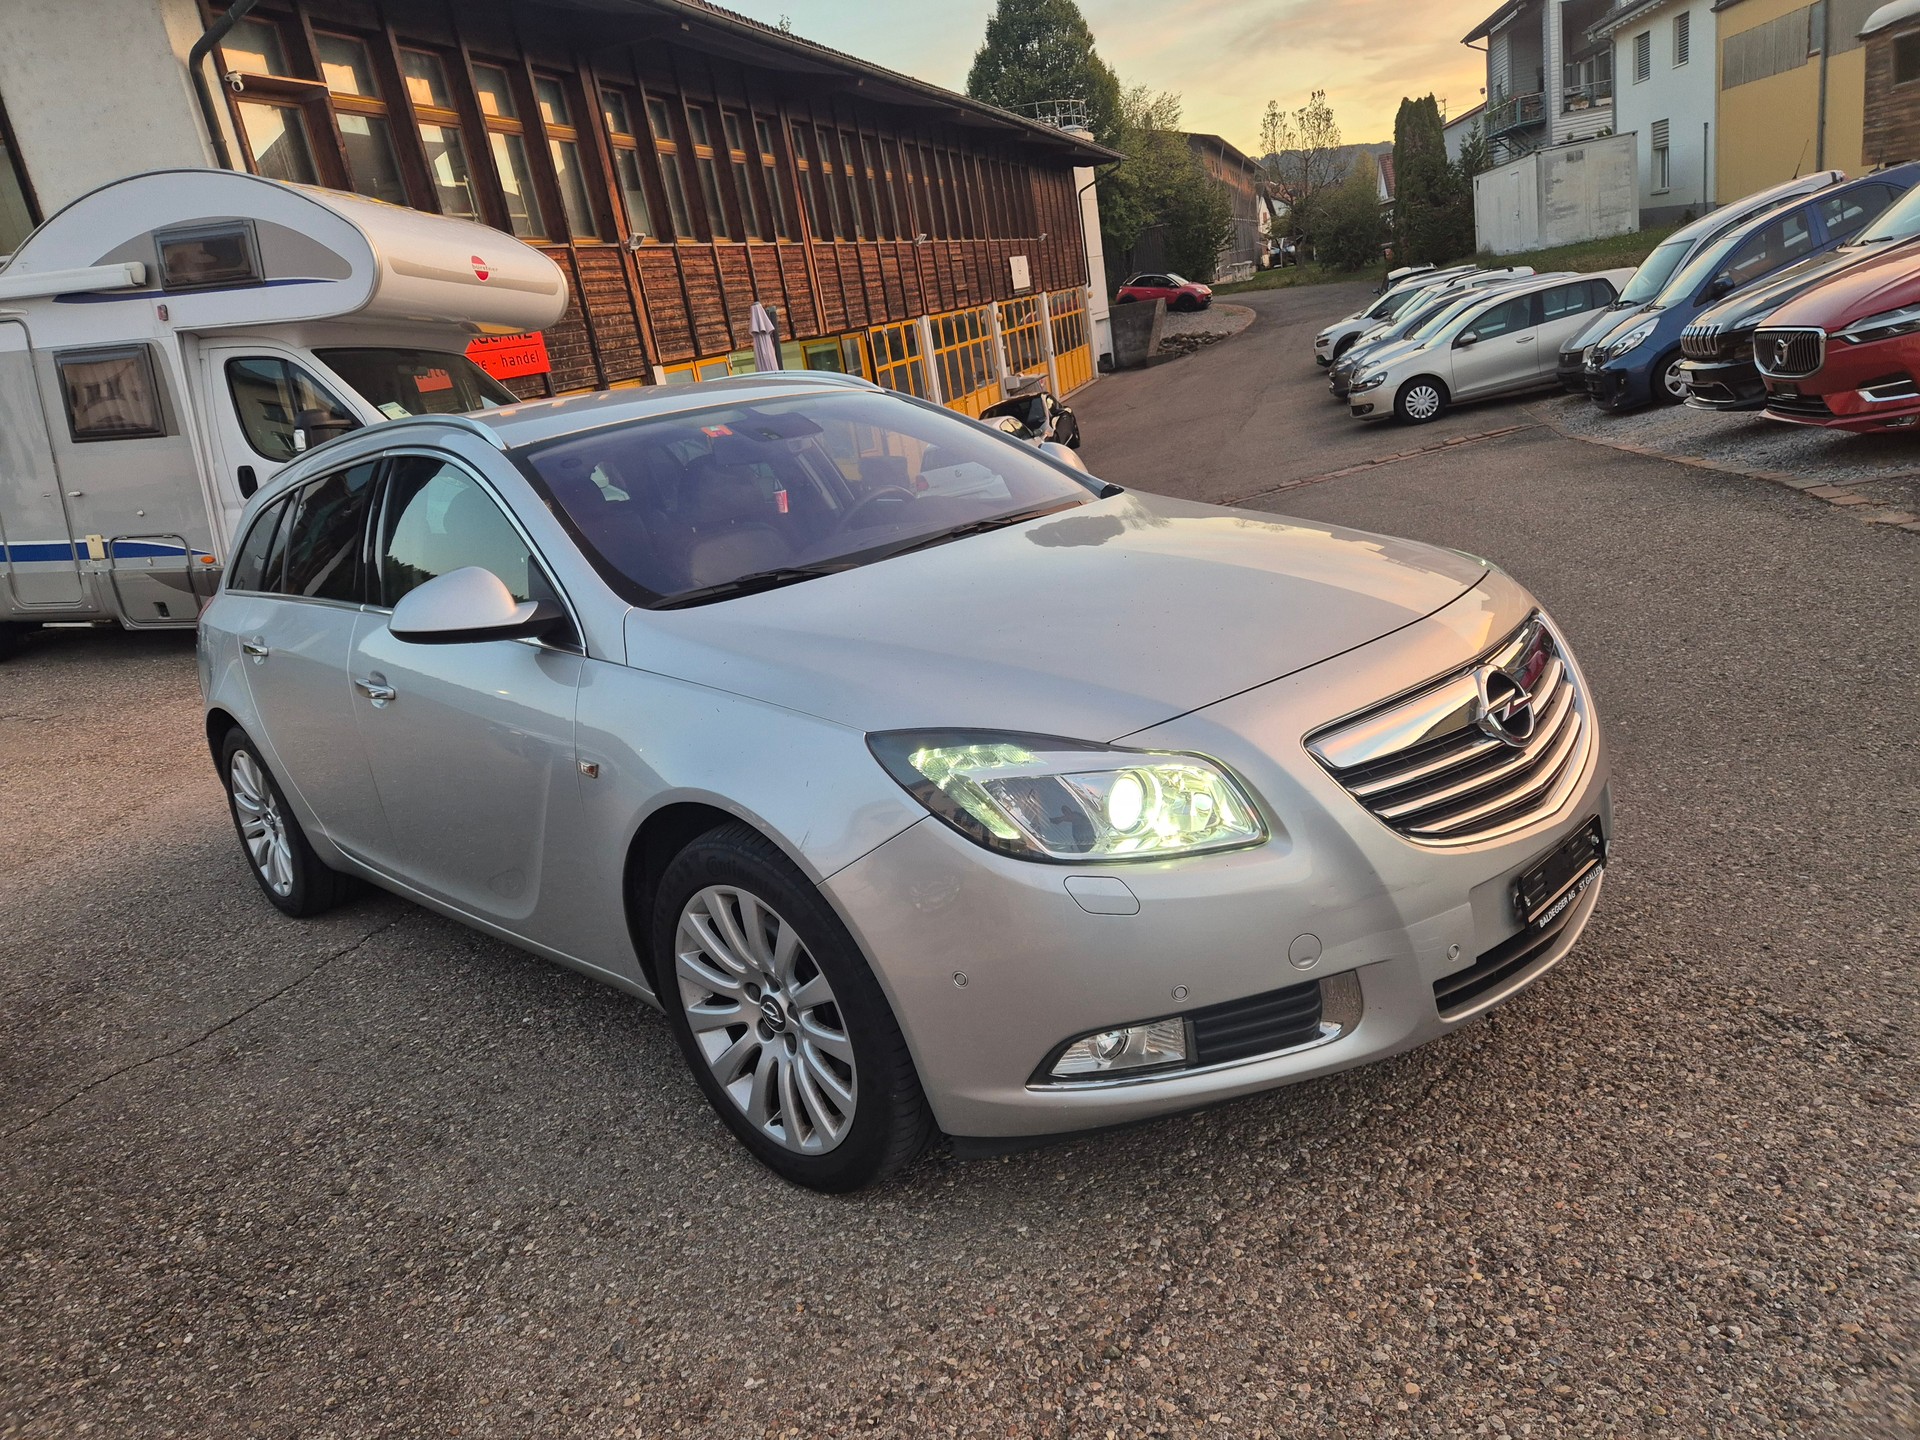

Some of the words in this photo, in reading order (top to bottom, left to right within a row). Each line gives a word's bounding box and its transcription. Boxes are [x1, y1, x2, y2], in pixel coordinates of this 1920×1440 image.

[500, 350, 540, 367] handel
[1539, 897, 1568, 928] BALDEGGER
[1568, 890, 1576, 901] AG
[1585, 864, 1603, 884] GALLEN
